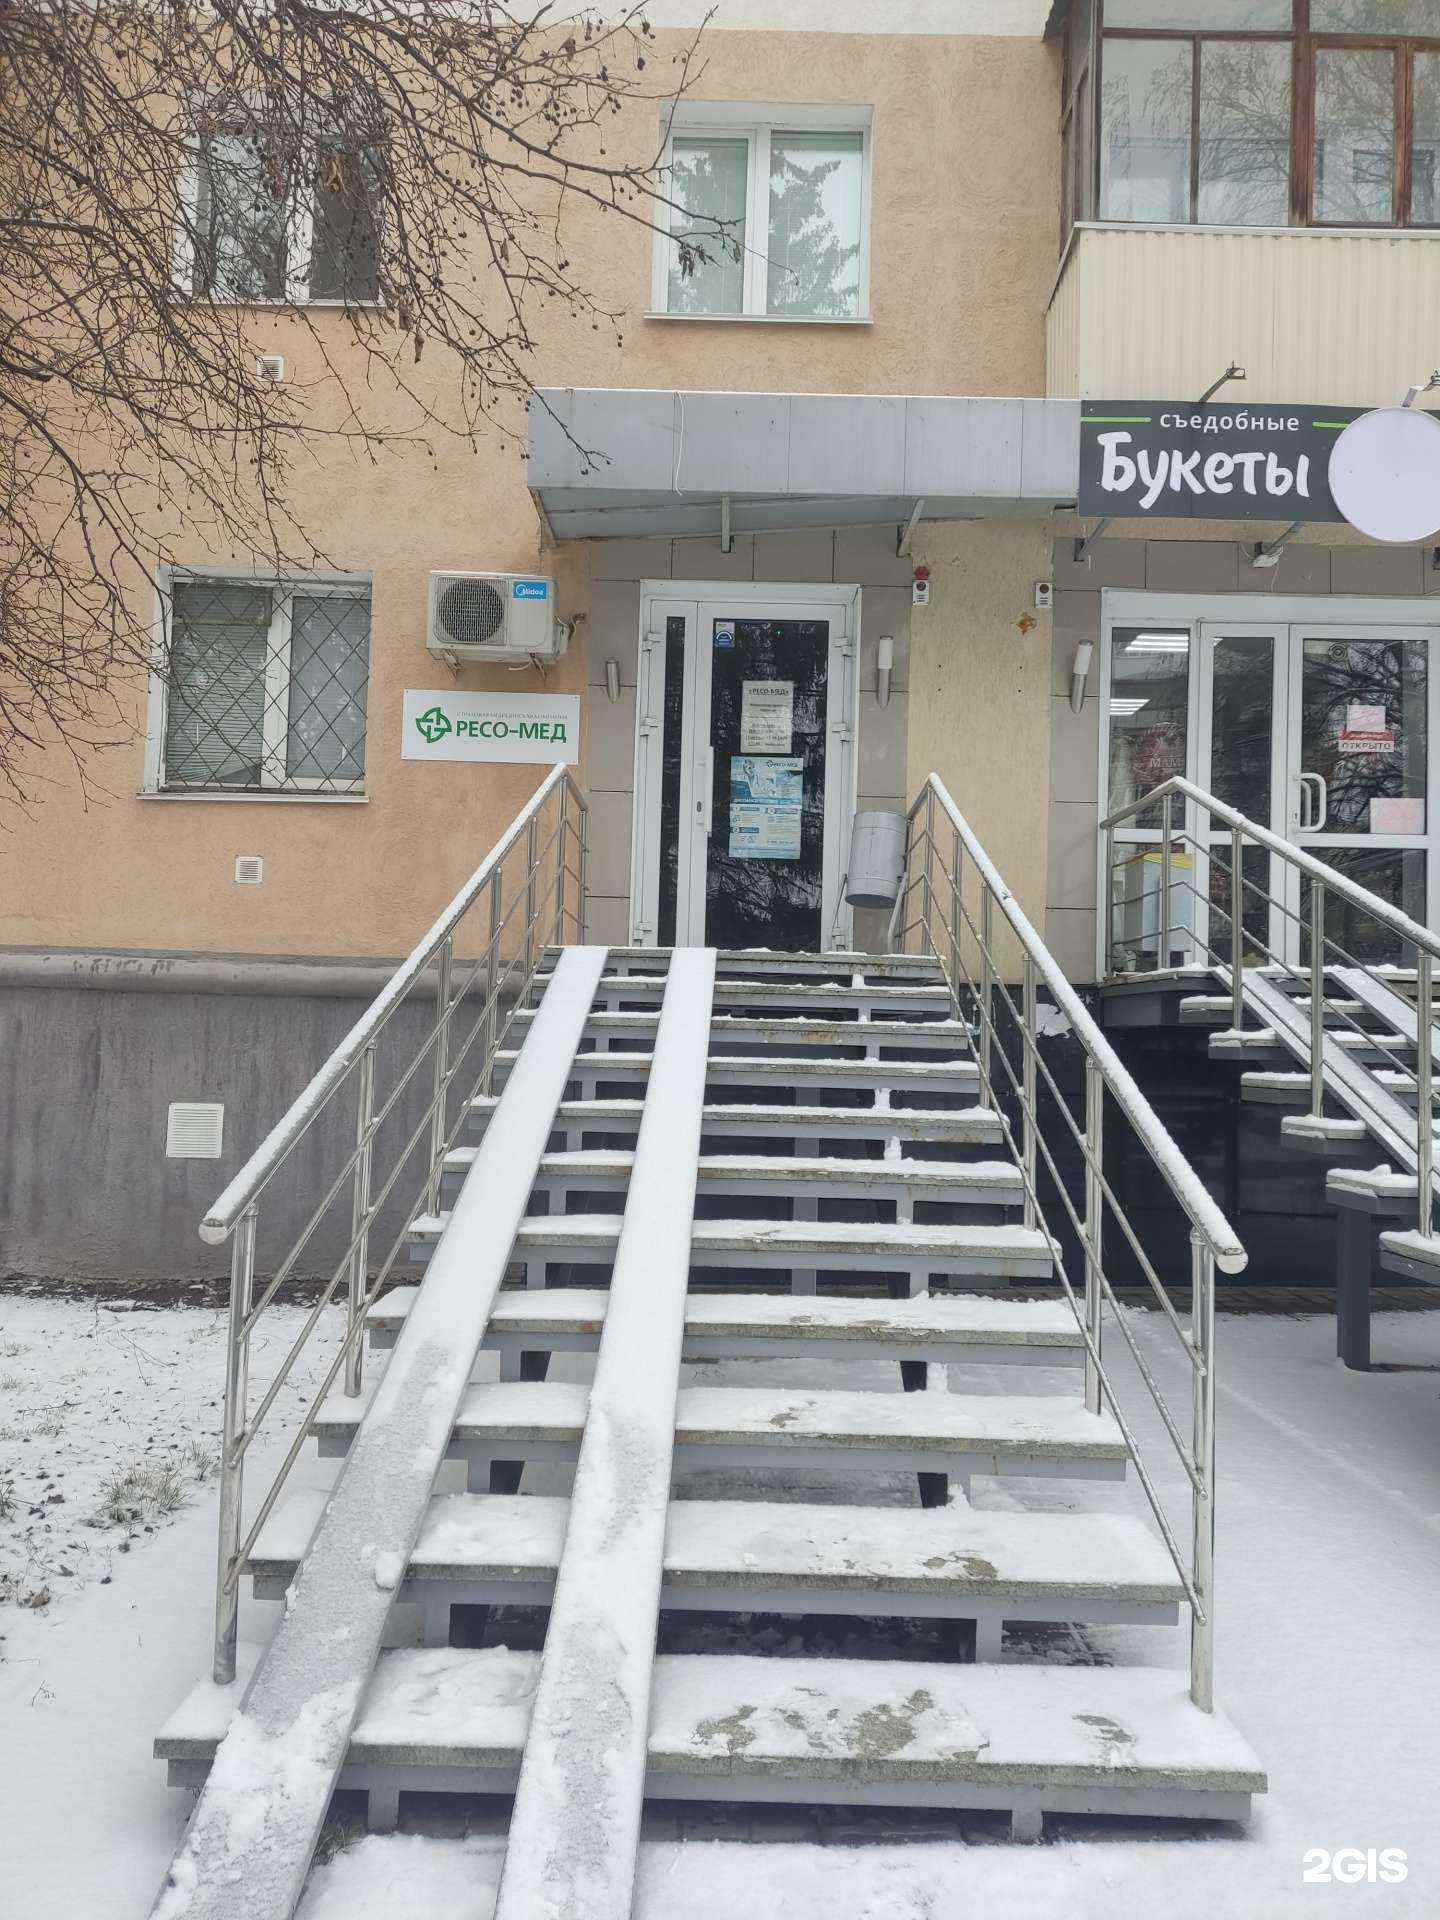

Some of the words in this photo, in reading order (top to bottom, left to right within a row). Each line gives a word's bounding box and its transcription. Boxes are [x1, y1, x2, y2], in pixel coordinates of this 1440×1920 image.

[1160, 410, 1300, 433] съедобные
[1096, 431, 1311, 510] Букеты
[520, 586, 544, 596] Midea
[456, 720, 567, 743] РЕСО-МЕД
[1342, 742, 1391, 750] ОТКРЫТО
